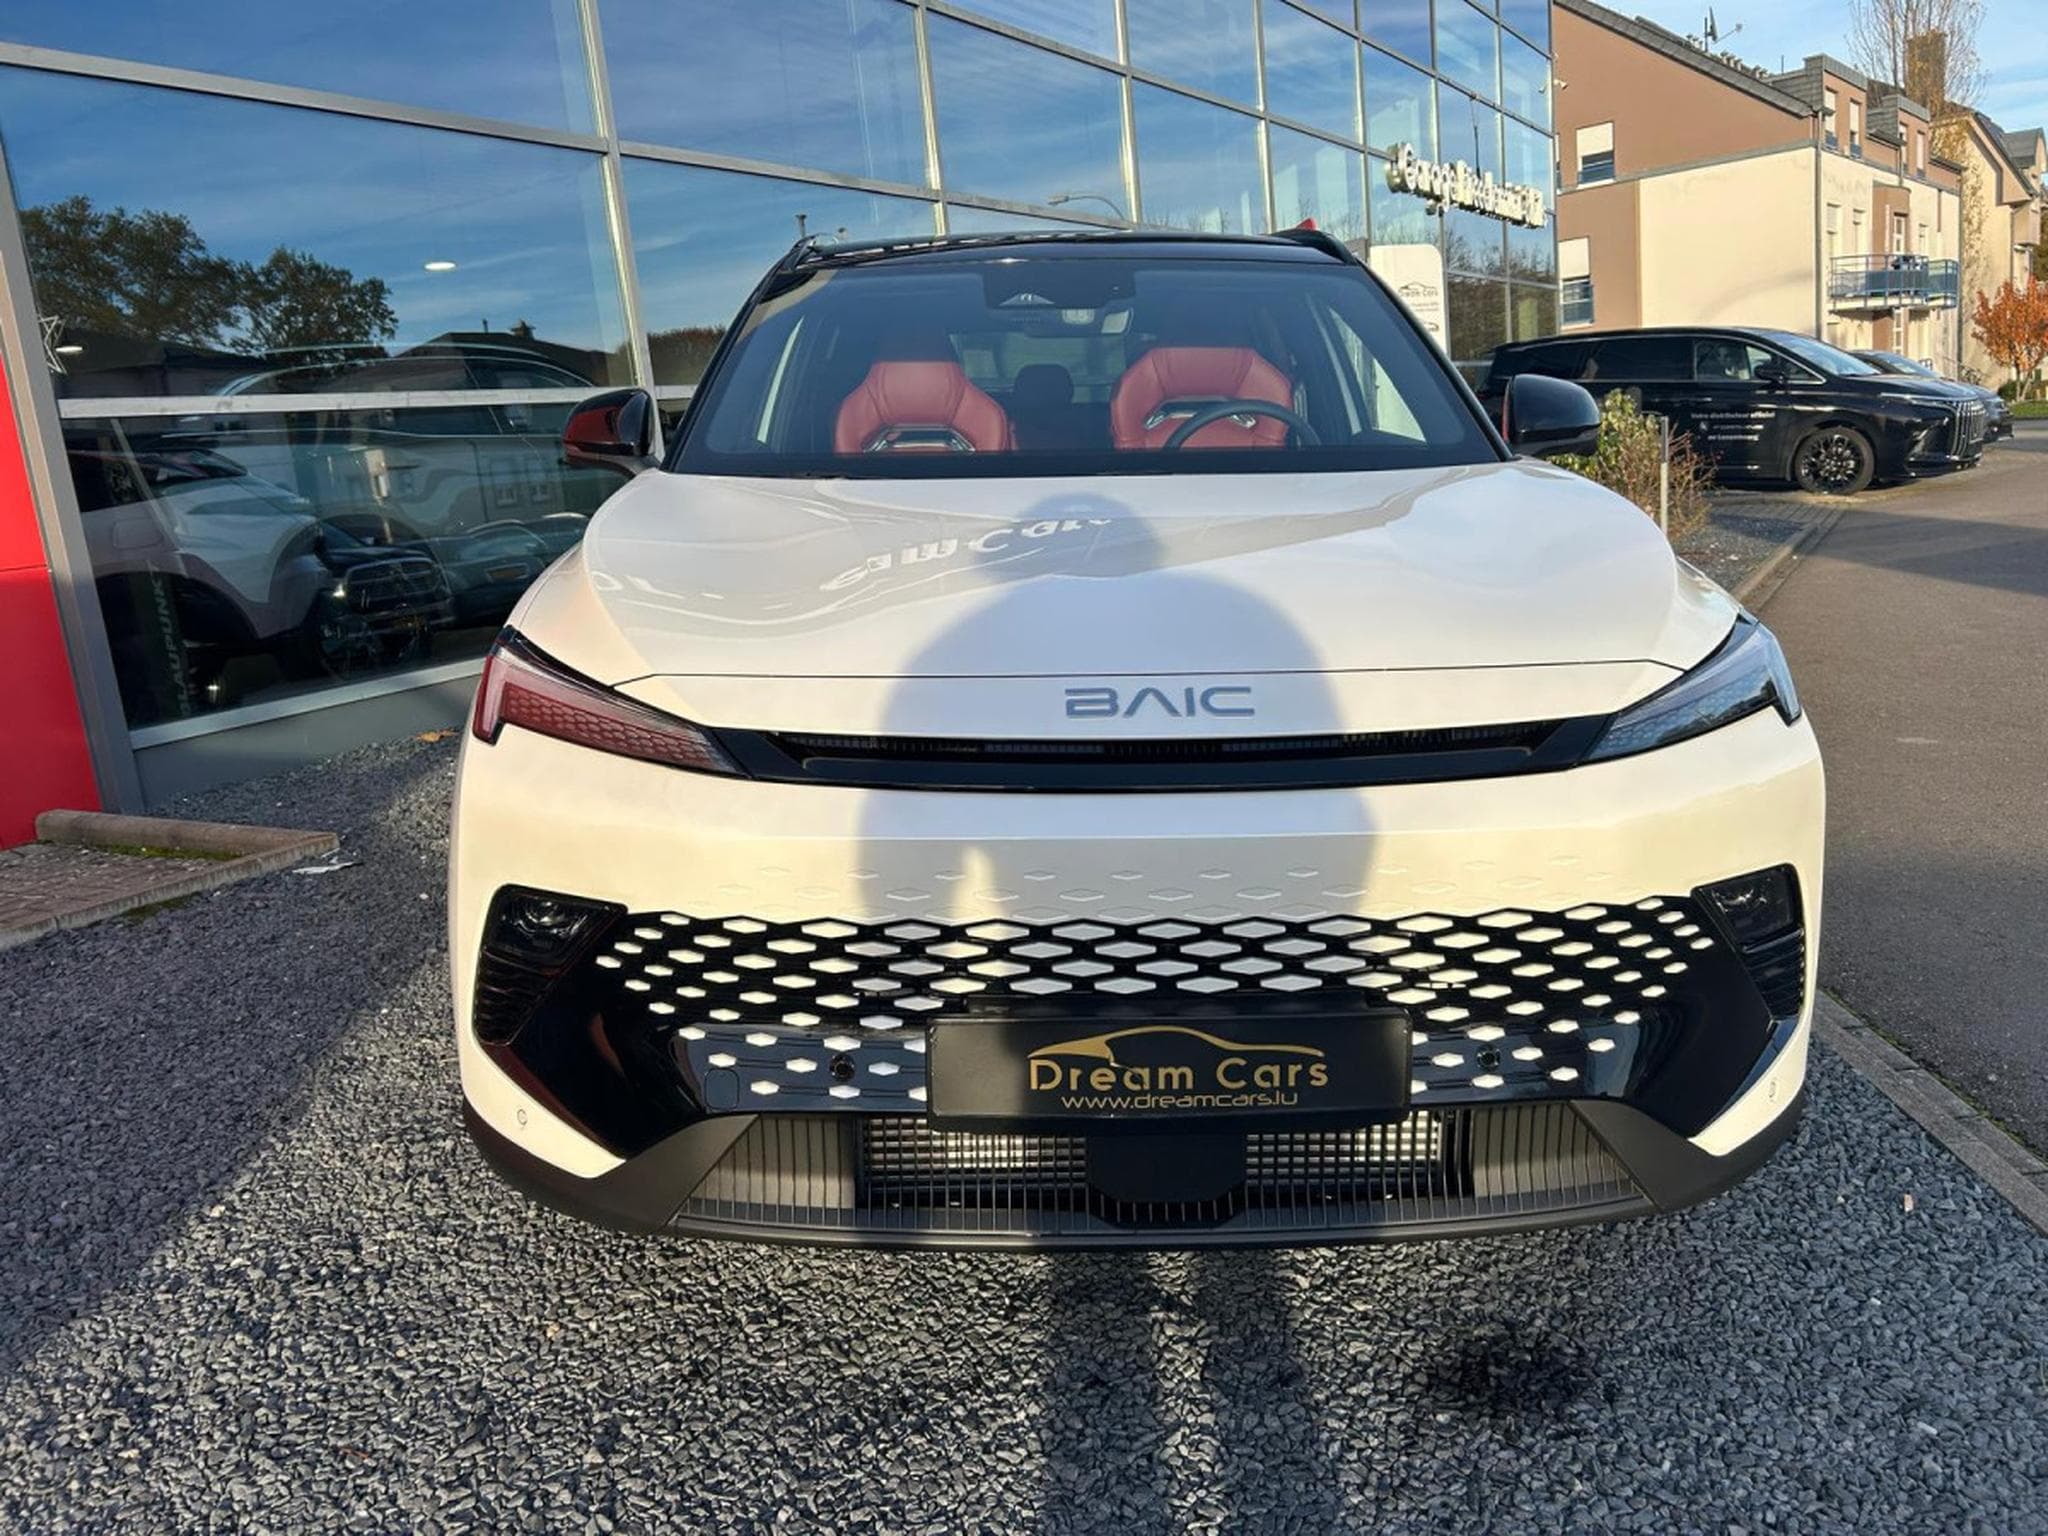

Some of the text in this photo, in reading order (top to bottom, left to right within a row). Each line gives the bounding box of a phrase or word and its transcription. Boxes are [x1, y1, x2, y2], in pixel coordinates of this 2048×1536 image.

[1065, 687, 1255, 718] BAIC
[1030, 1057, 1329, 1091] Dream Cars
[1061, 1090, 1298, 1109] www.dreamcars.lu
